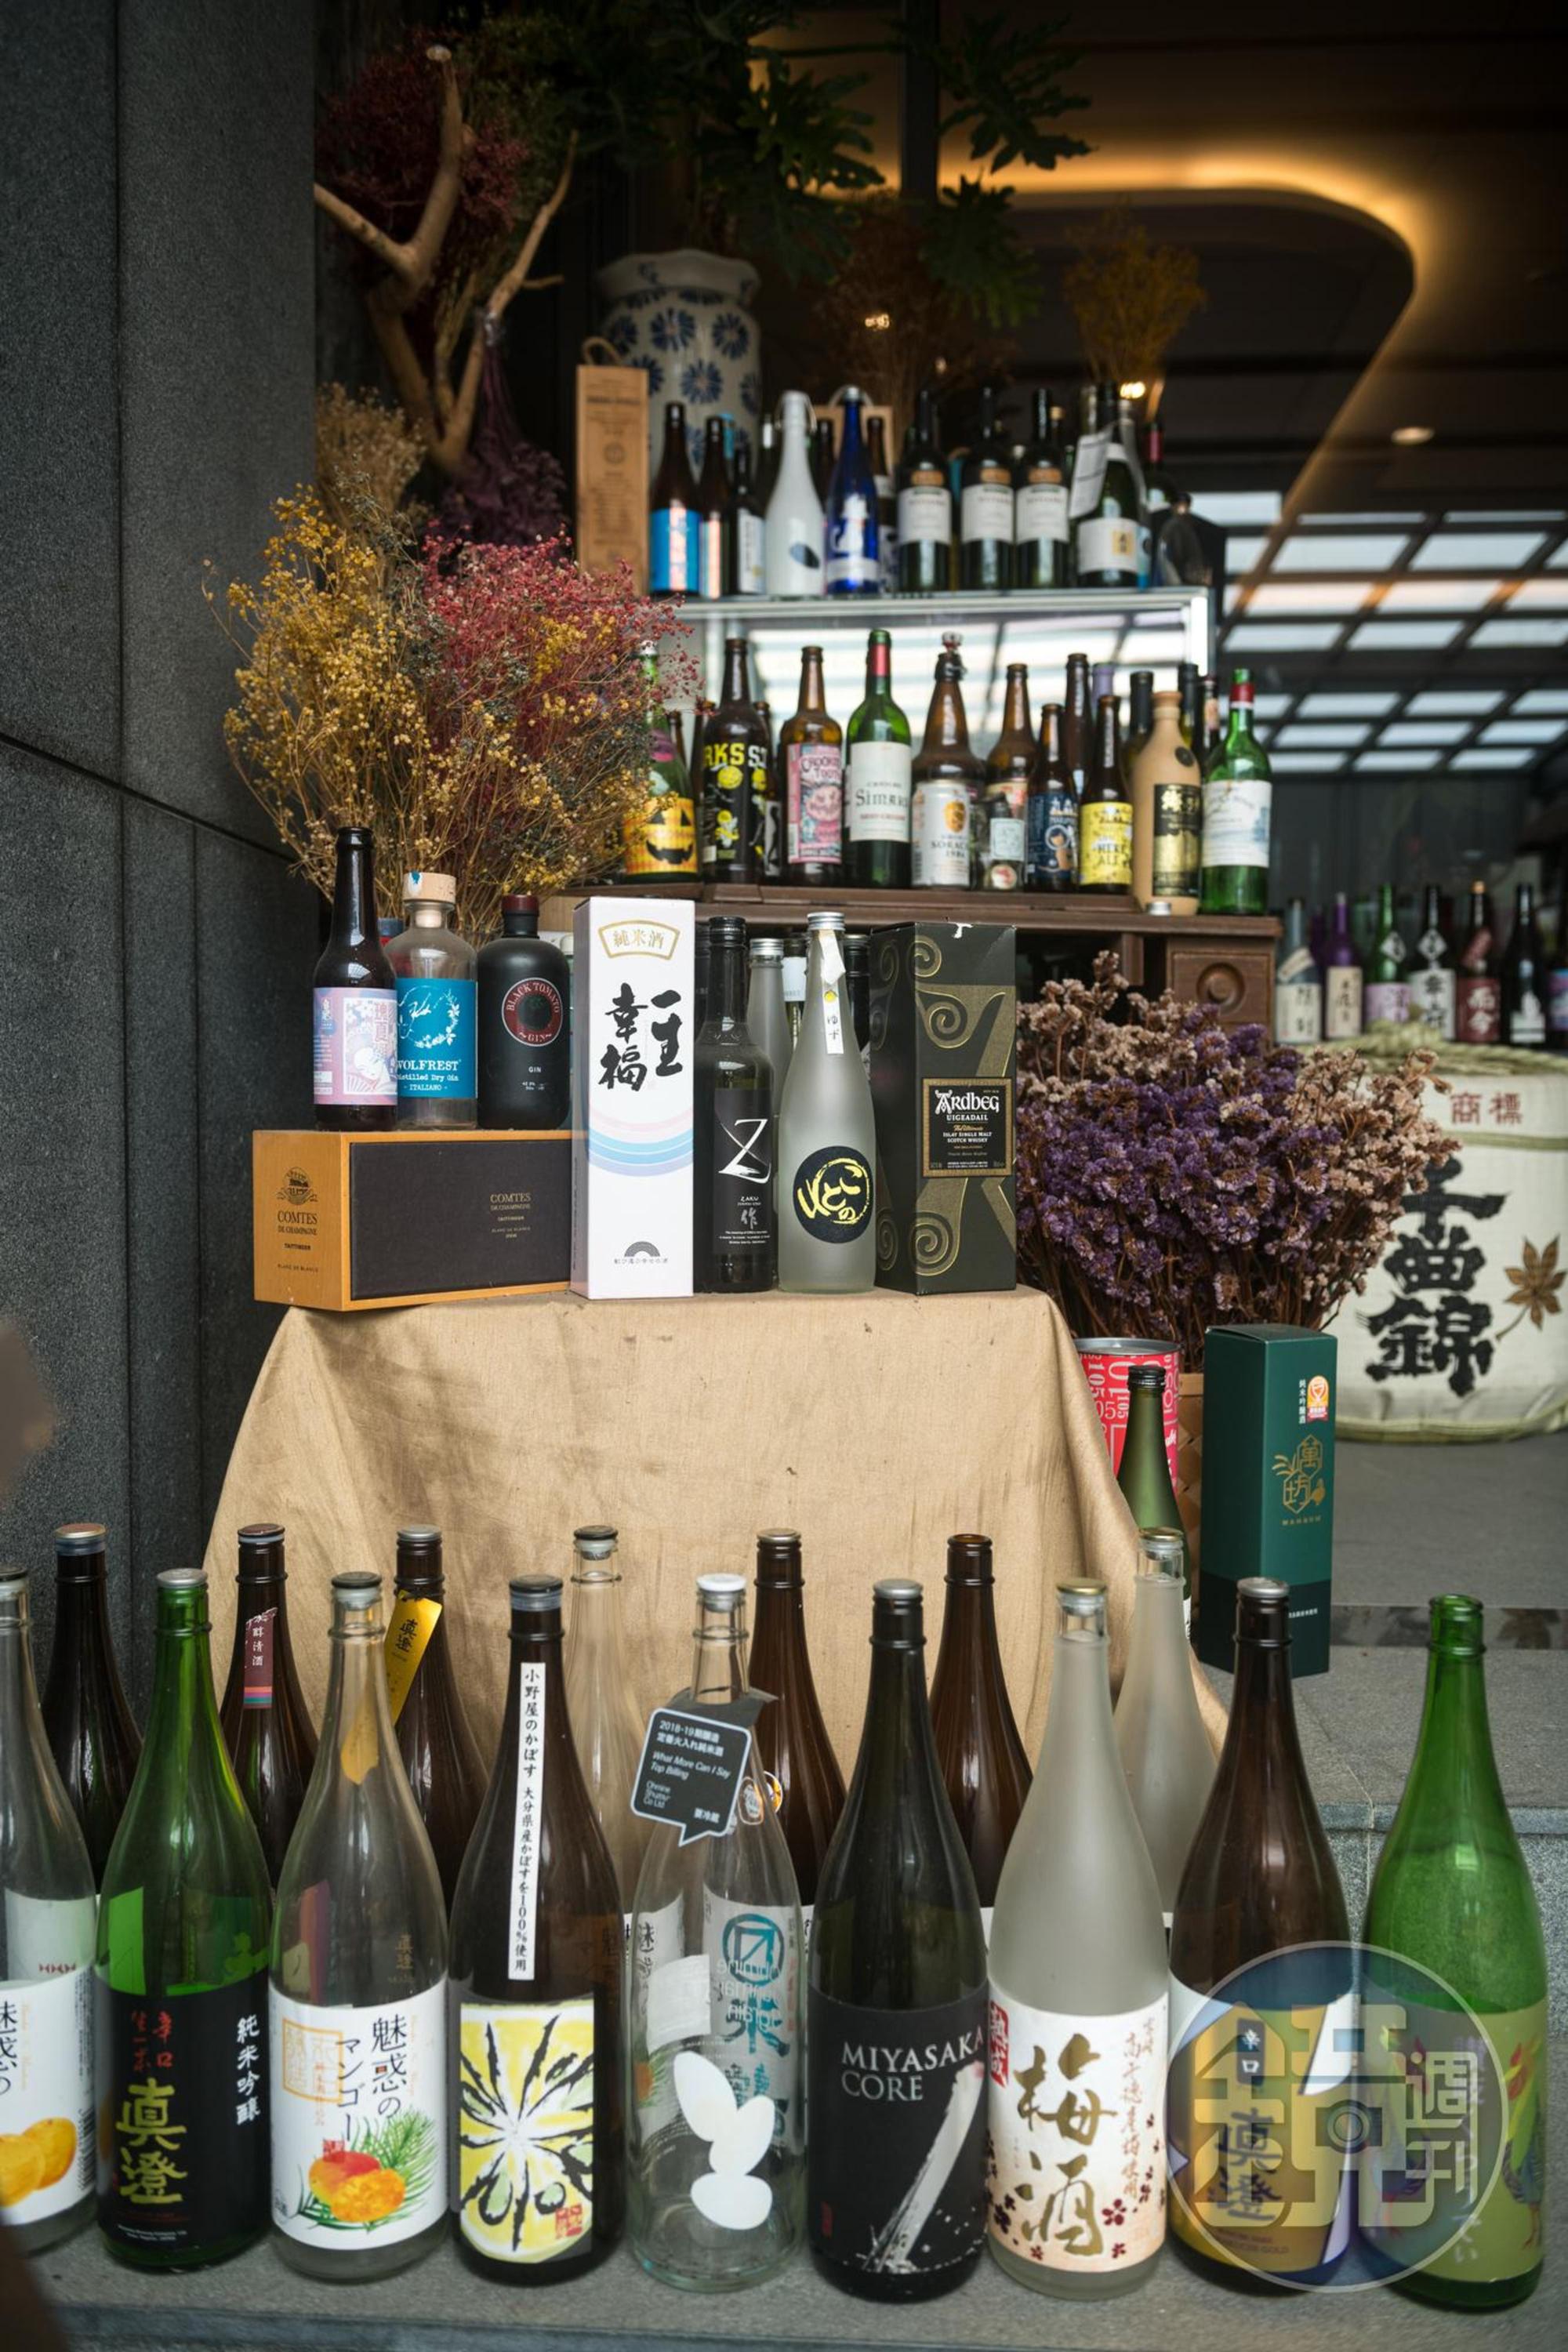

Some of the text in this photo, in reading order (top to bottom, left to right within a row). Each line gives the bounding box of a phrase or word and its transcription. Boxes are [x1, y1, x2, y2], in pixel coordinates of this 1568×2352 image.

[277, 1210, 318, 1225] COMTES
[490, 1192, 532, 1203] COMTES
[523, 1668, 541, 1778] 小野屋のかぼす
[650, 1762, 665, 1774] Top
[673, 1755, 695, 1769] More
[695, 1762, 712, 1773] Can
[716, 1767, 731, 1780] Say
[236, 2013, 261, 2126] 純米吟醸
[372, 2013, 408, 2118] 魅惑の
[841, 2025, 985, 2074] MIYASAKA
[335, 2038, 365, 2142] マンゴー
[840, 2069, 924, 2101] CORE
[1013, 2033, 1118, 2256] 梅酒
